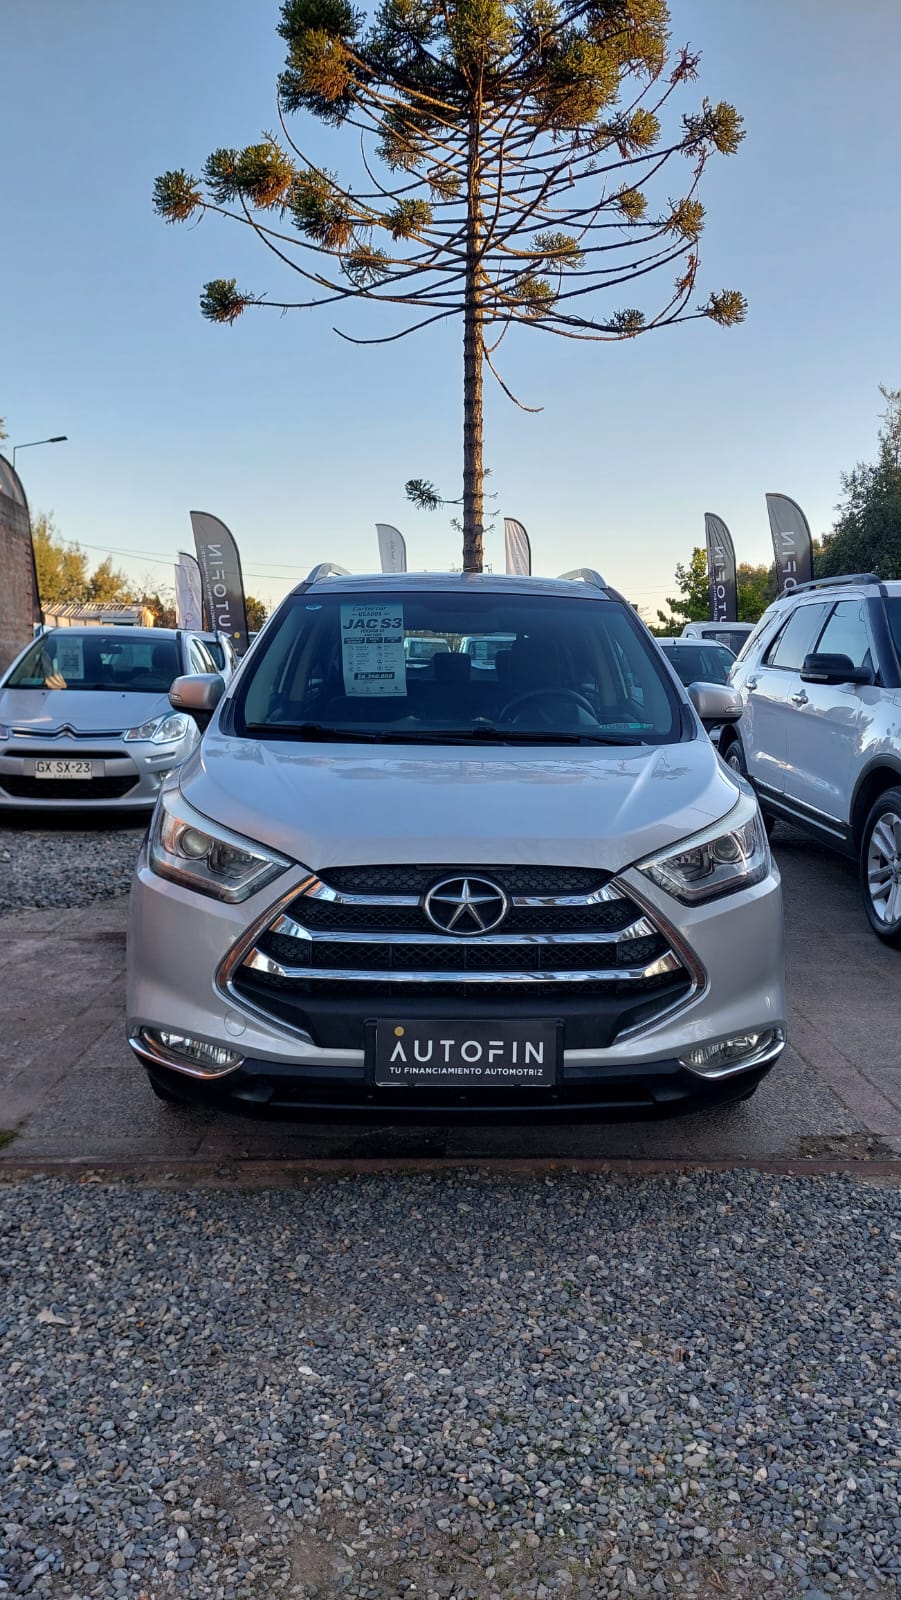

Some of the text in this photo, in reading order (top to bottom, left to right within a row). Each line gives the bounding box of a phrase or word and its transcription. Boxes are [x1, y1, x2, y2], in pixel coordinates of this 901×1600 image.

[37, 761, 90, 773] GX SX-23
[389, 1039, 544, 1064] AUTOFIN
[404, 1067, 482, 1075] FINANCIAMIENTO
[485, 1068, 544, 1076] AUTOMOTRIZ
